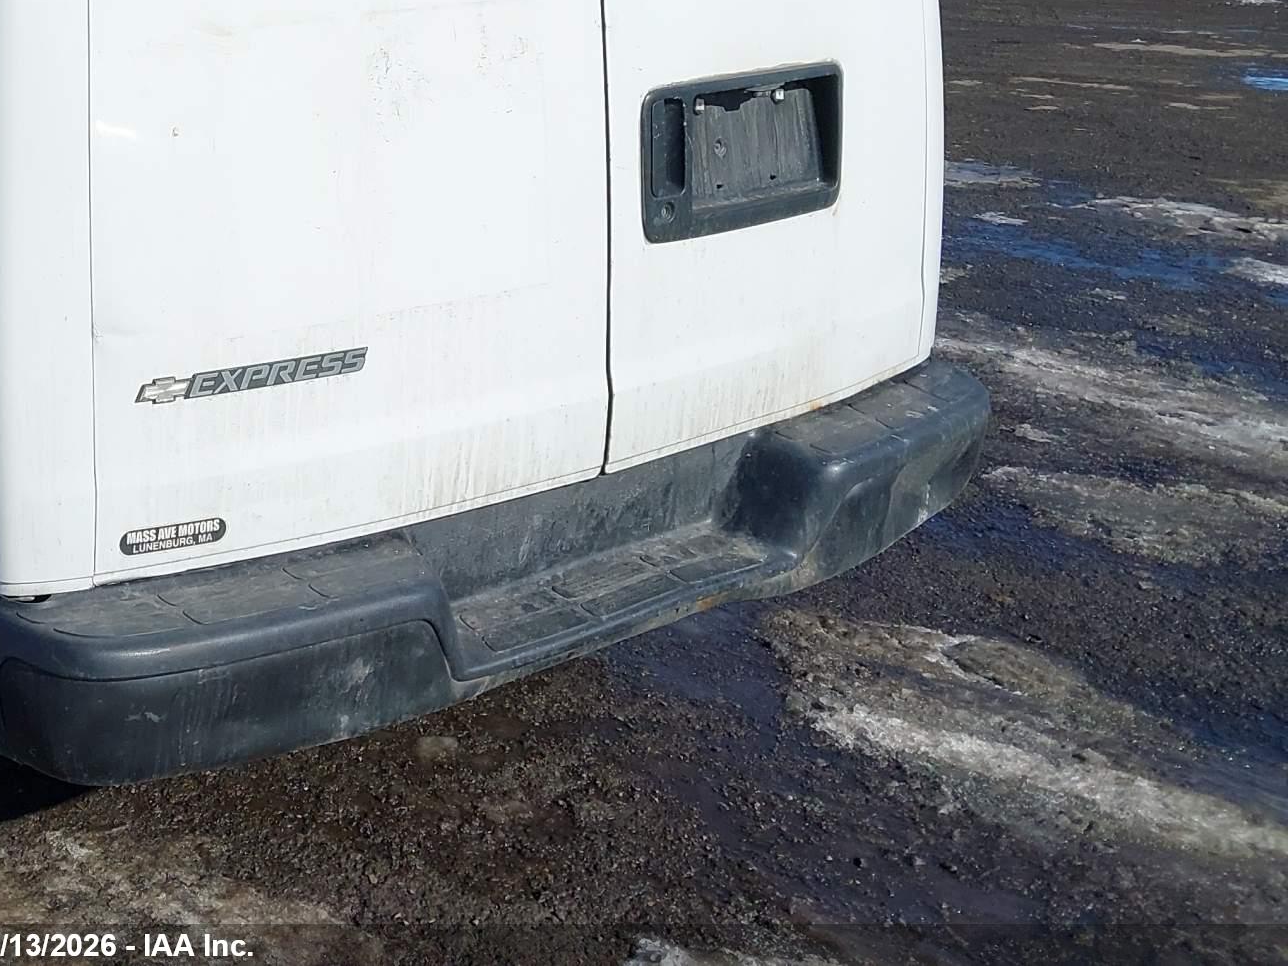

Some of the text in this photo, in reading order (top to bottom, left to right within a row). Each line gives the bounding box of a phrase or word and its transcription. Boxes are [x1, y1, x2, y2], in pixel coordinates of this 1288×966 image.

[189, 349, 367, 398] EXPRESS
[126, 519, 220, 545] MASS AVE MOTORS
[132, 533, 213, 554] LUNENBURG, MA
